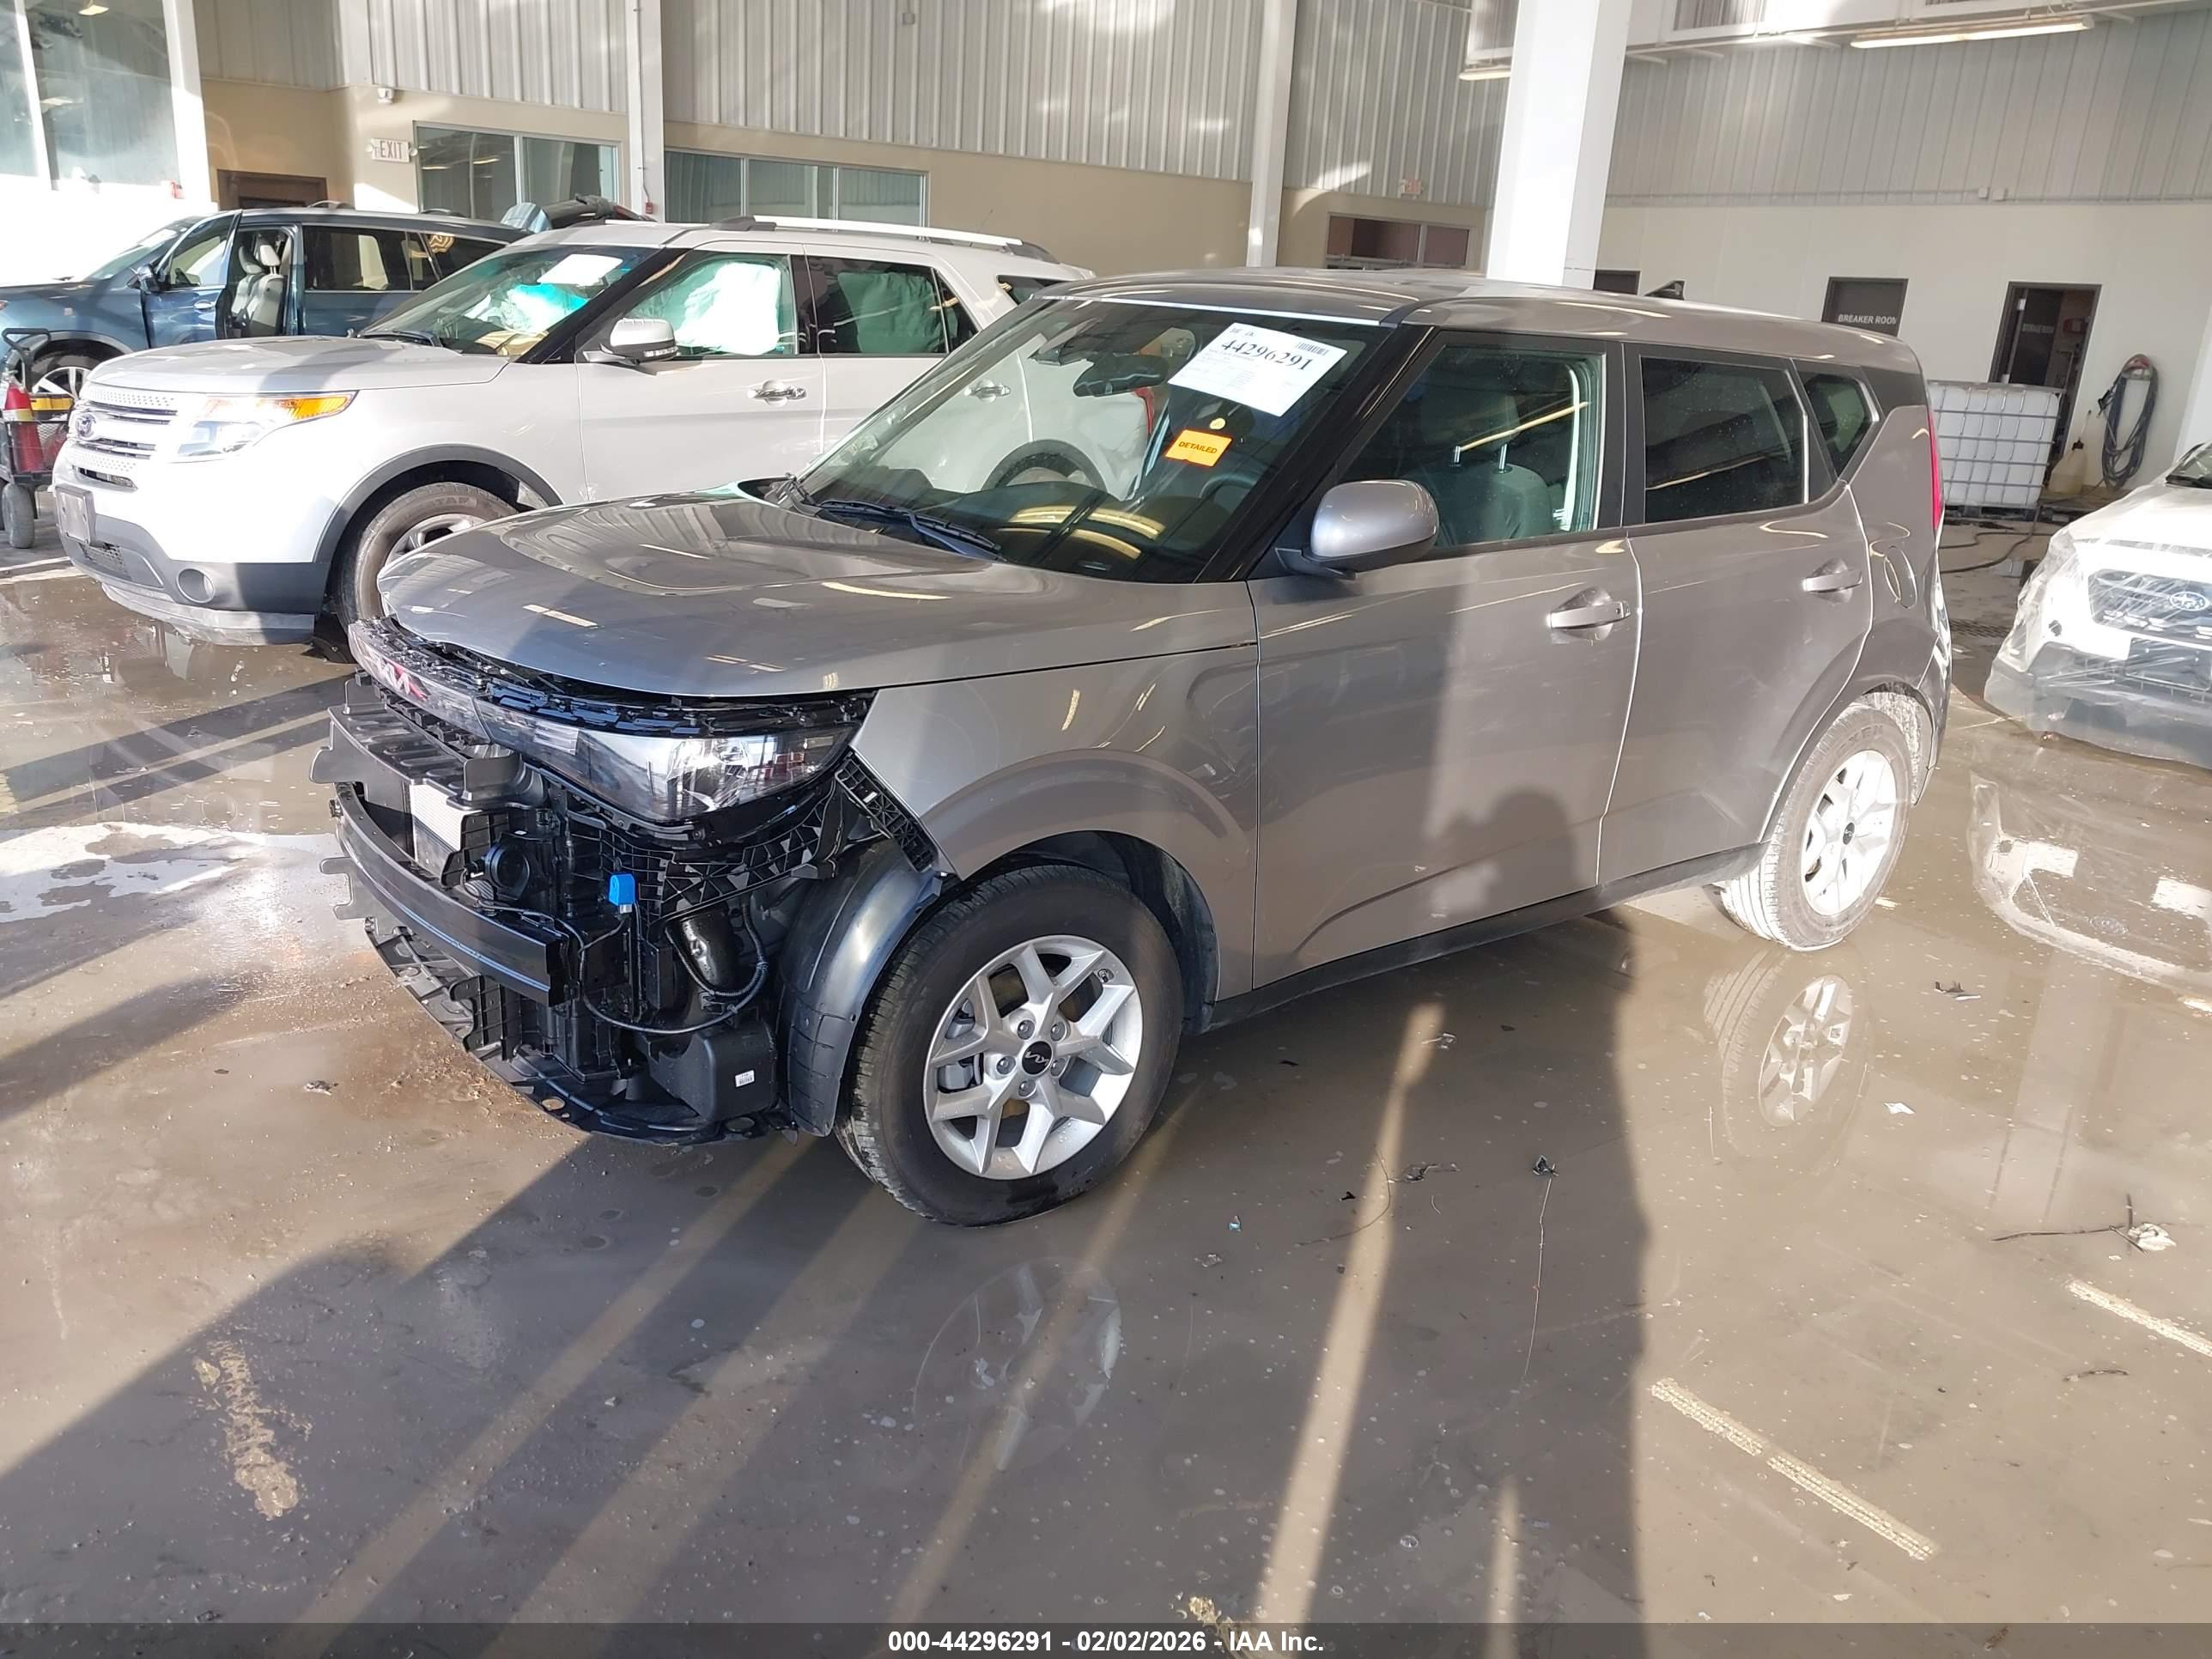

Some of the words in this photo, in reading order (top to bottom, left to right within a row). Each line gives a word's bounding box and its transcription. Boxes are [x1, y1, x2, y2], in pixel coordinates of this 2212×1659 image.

[380, 140, 403, 160] EXIT
[1838, 314, 1874, 324] BREAKER
[1221, 339, 1313, 370] 44296291
[1178, 441, 1218, 454] DETAILED
